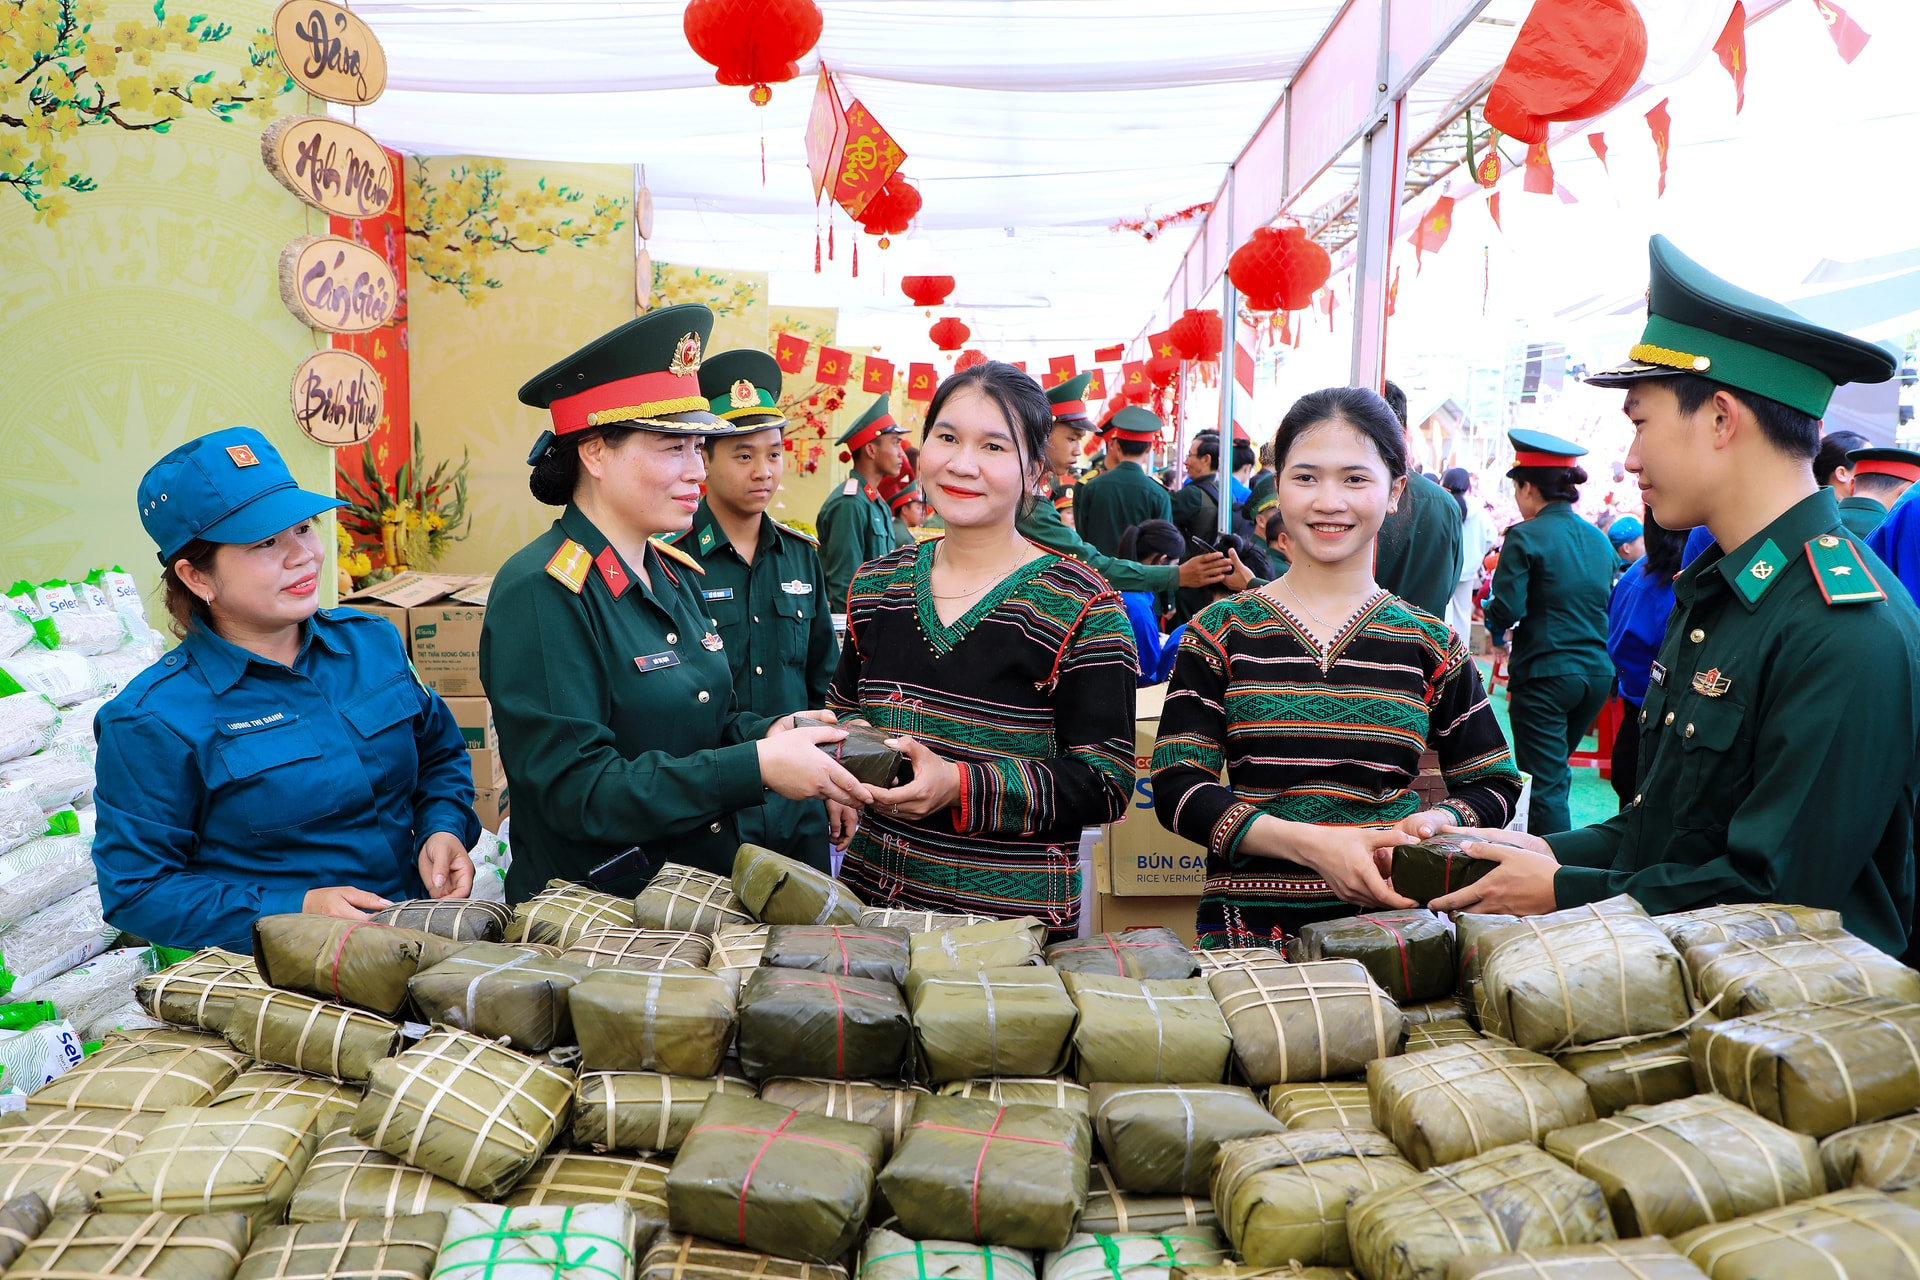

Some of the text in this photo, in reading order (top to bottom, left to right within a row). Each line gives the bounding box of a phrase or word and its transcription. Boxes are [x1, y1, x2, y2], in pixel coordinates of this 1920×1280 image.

[296, 9, 367, 100] Đảng
[295, 132, 389, 215] Anh Minh
[301, 250, 351, 327] Cán
[297, 367, 347, 433] Binh
[1137, 852, 1208, 873] BÚN GẠ
[1137, 874, 1159, 883] RICE
